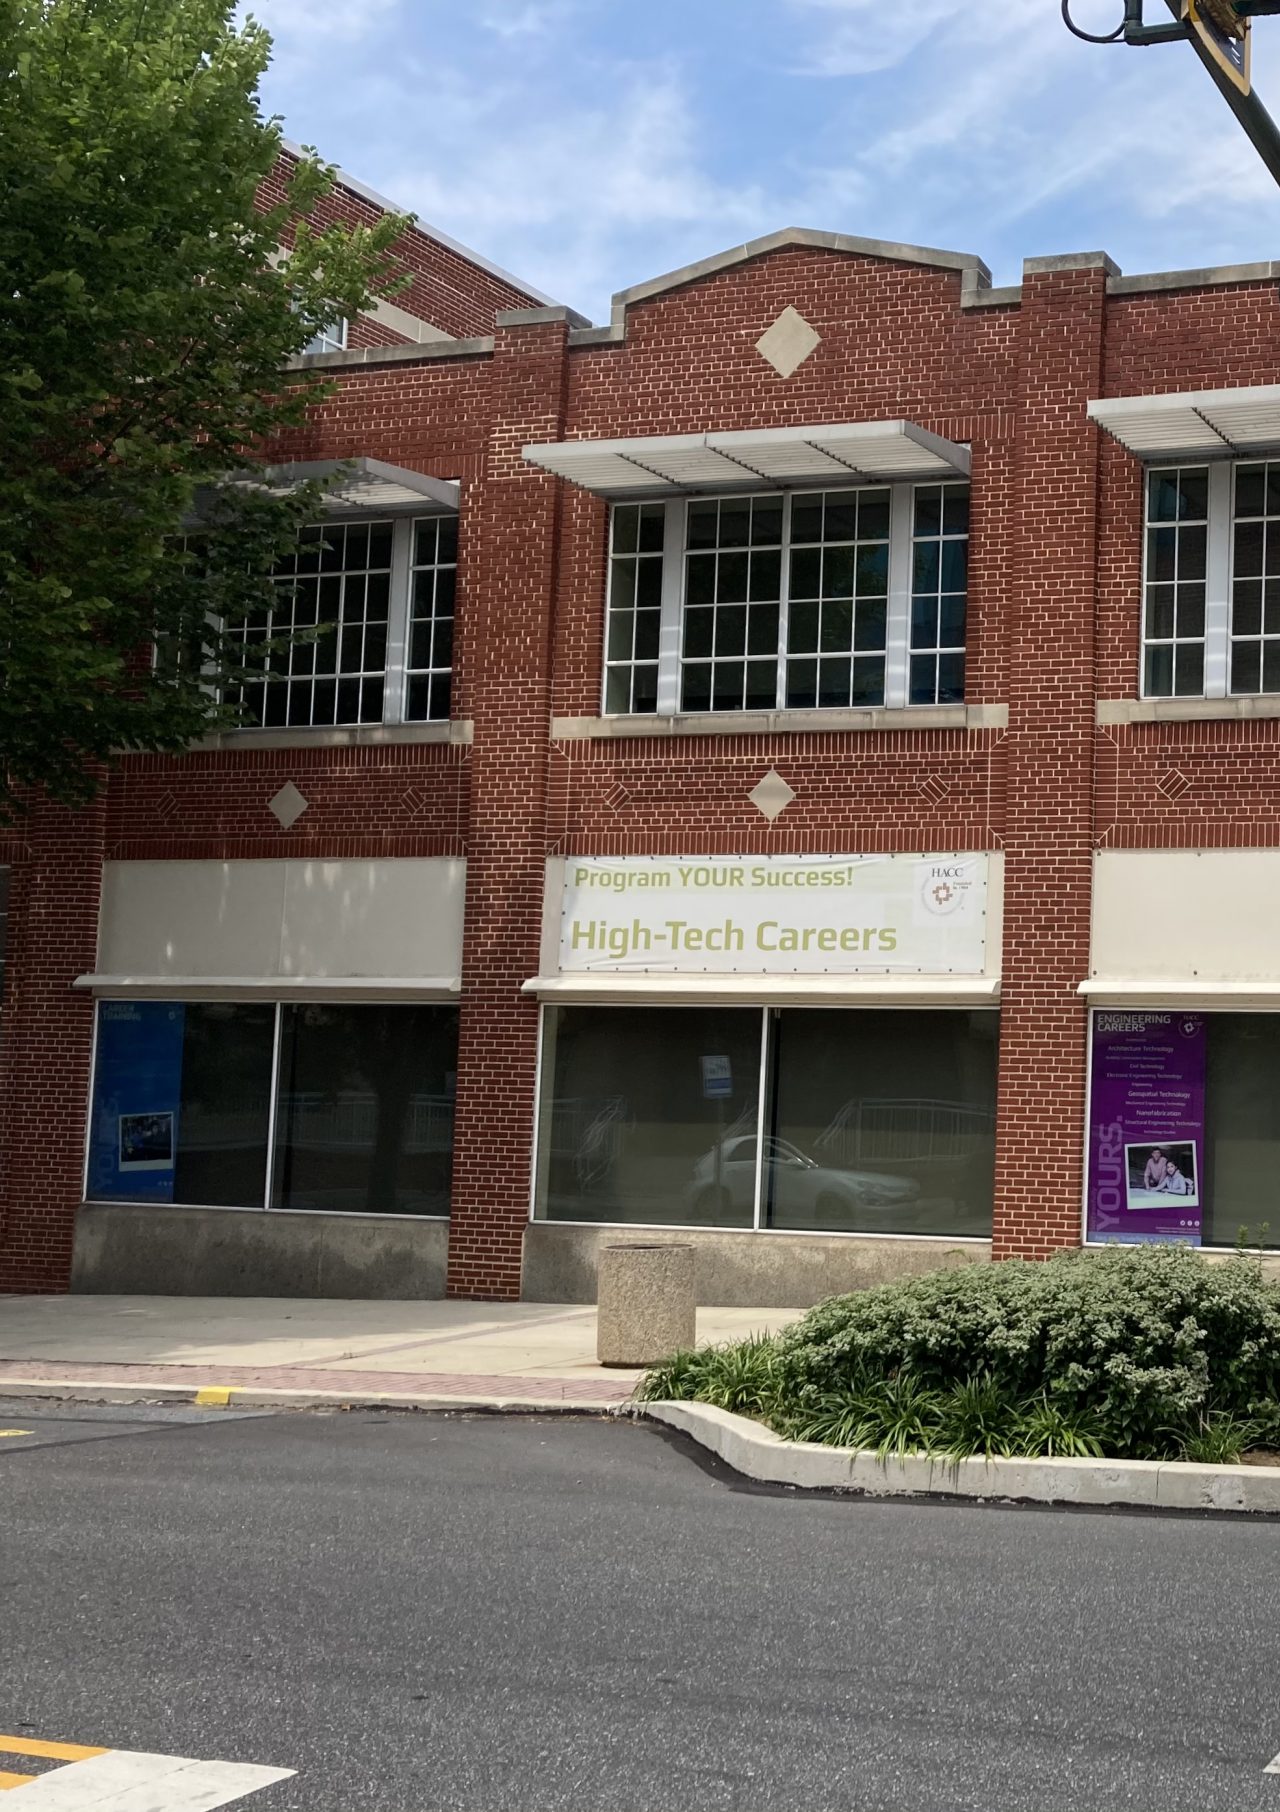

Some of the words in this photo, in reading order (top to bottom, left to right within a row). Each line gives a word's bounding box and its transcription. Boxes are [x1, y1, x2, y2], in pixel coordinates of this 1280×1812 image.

[574, 867, 671, 893] Program
[678, 866, 745, 887] YOUR
[751, 865, 854, 888] Success!
[931, 867, 964, 878] HACC
[571, 918, 745, 959] High-Tech
[755, 921, 898, 952] Careers
[1097, 1014, 1171, 1024] ENGINEERING
[1097, 1023, 1146, 1033] CAREERS
[1096, 1115, 1123, 1232] YOURS.
